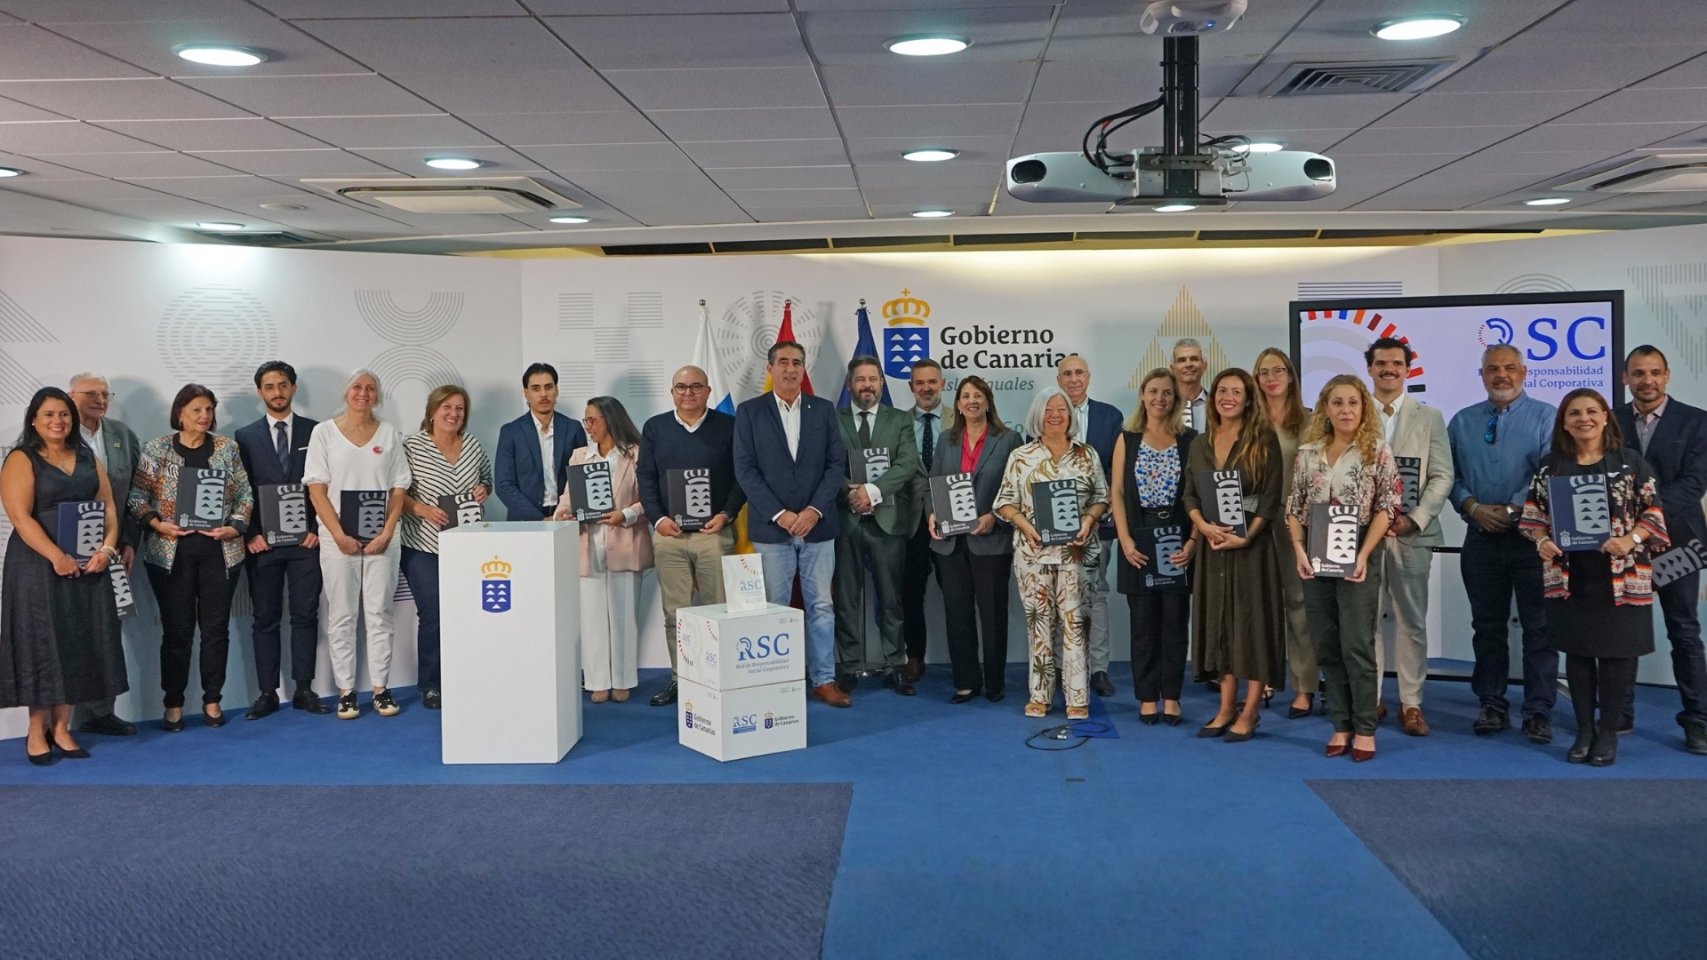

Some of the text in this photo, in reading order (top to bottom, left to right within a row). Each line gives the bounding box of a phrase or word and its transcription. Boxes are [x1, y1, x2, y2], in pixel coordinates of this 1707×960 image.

[940, 324, 1054, 345] Gobierno
[940, 347, 1079, 369] de Canaria
[1528, 366, 1603, 378] sponsabilidad
[1539, 379, 1603, 390] Corporativa
[740, 579, 762, 591] RSC
[736, 633, 790, 661] RSC
[733, 714, 757, 727] RSC
